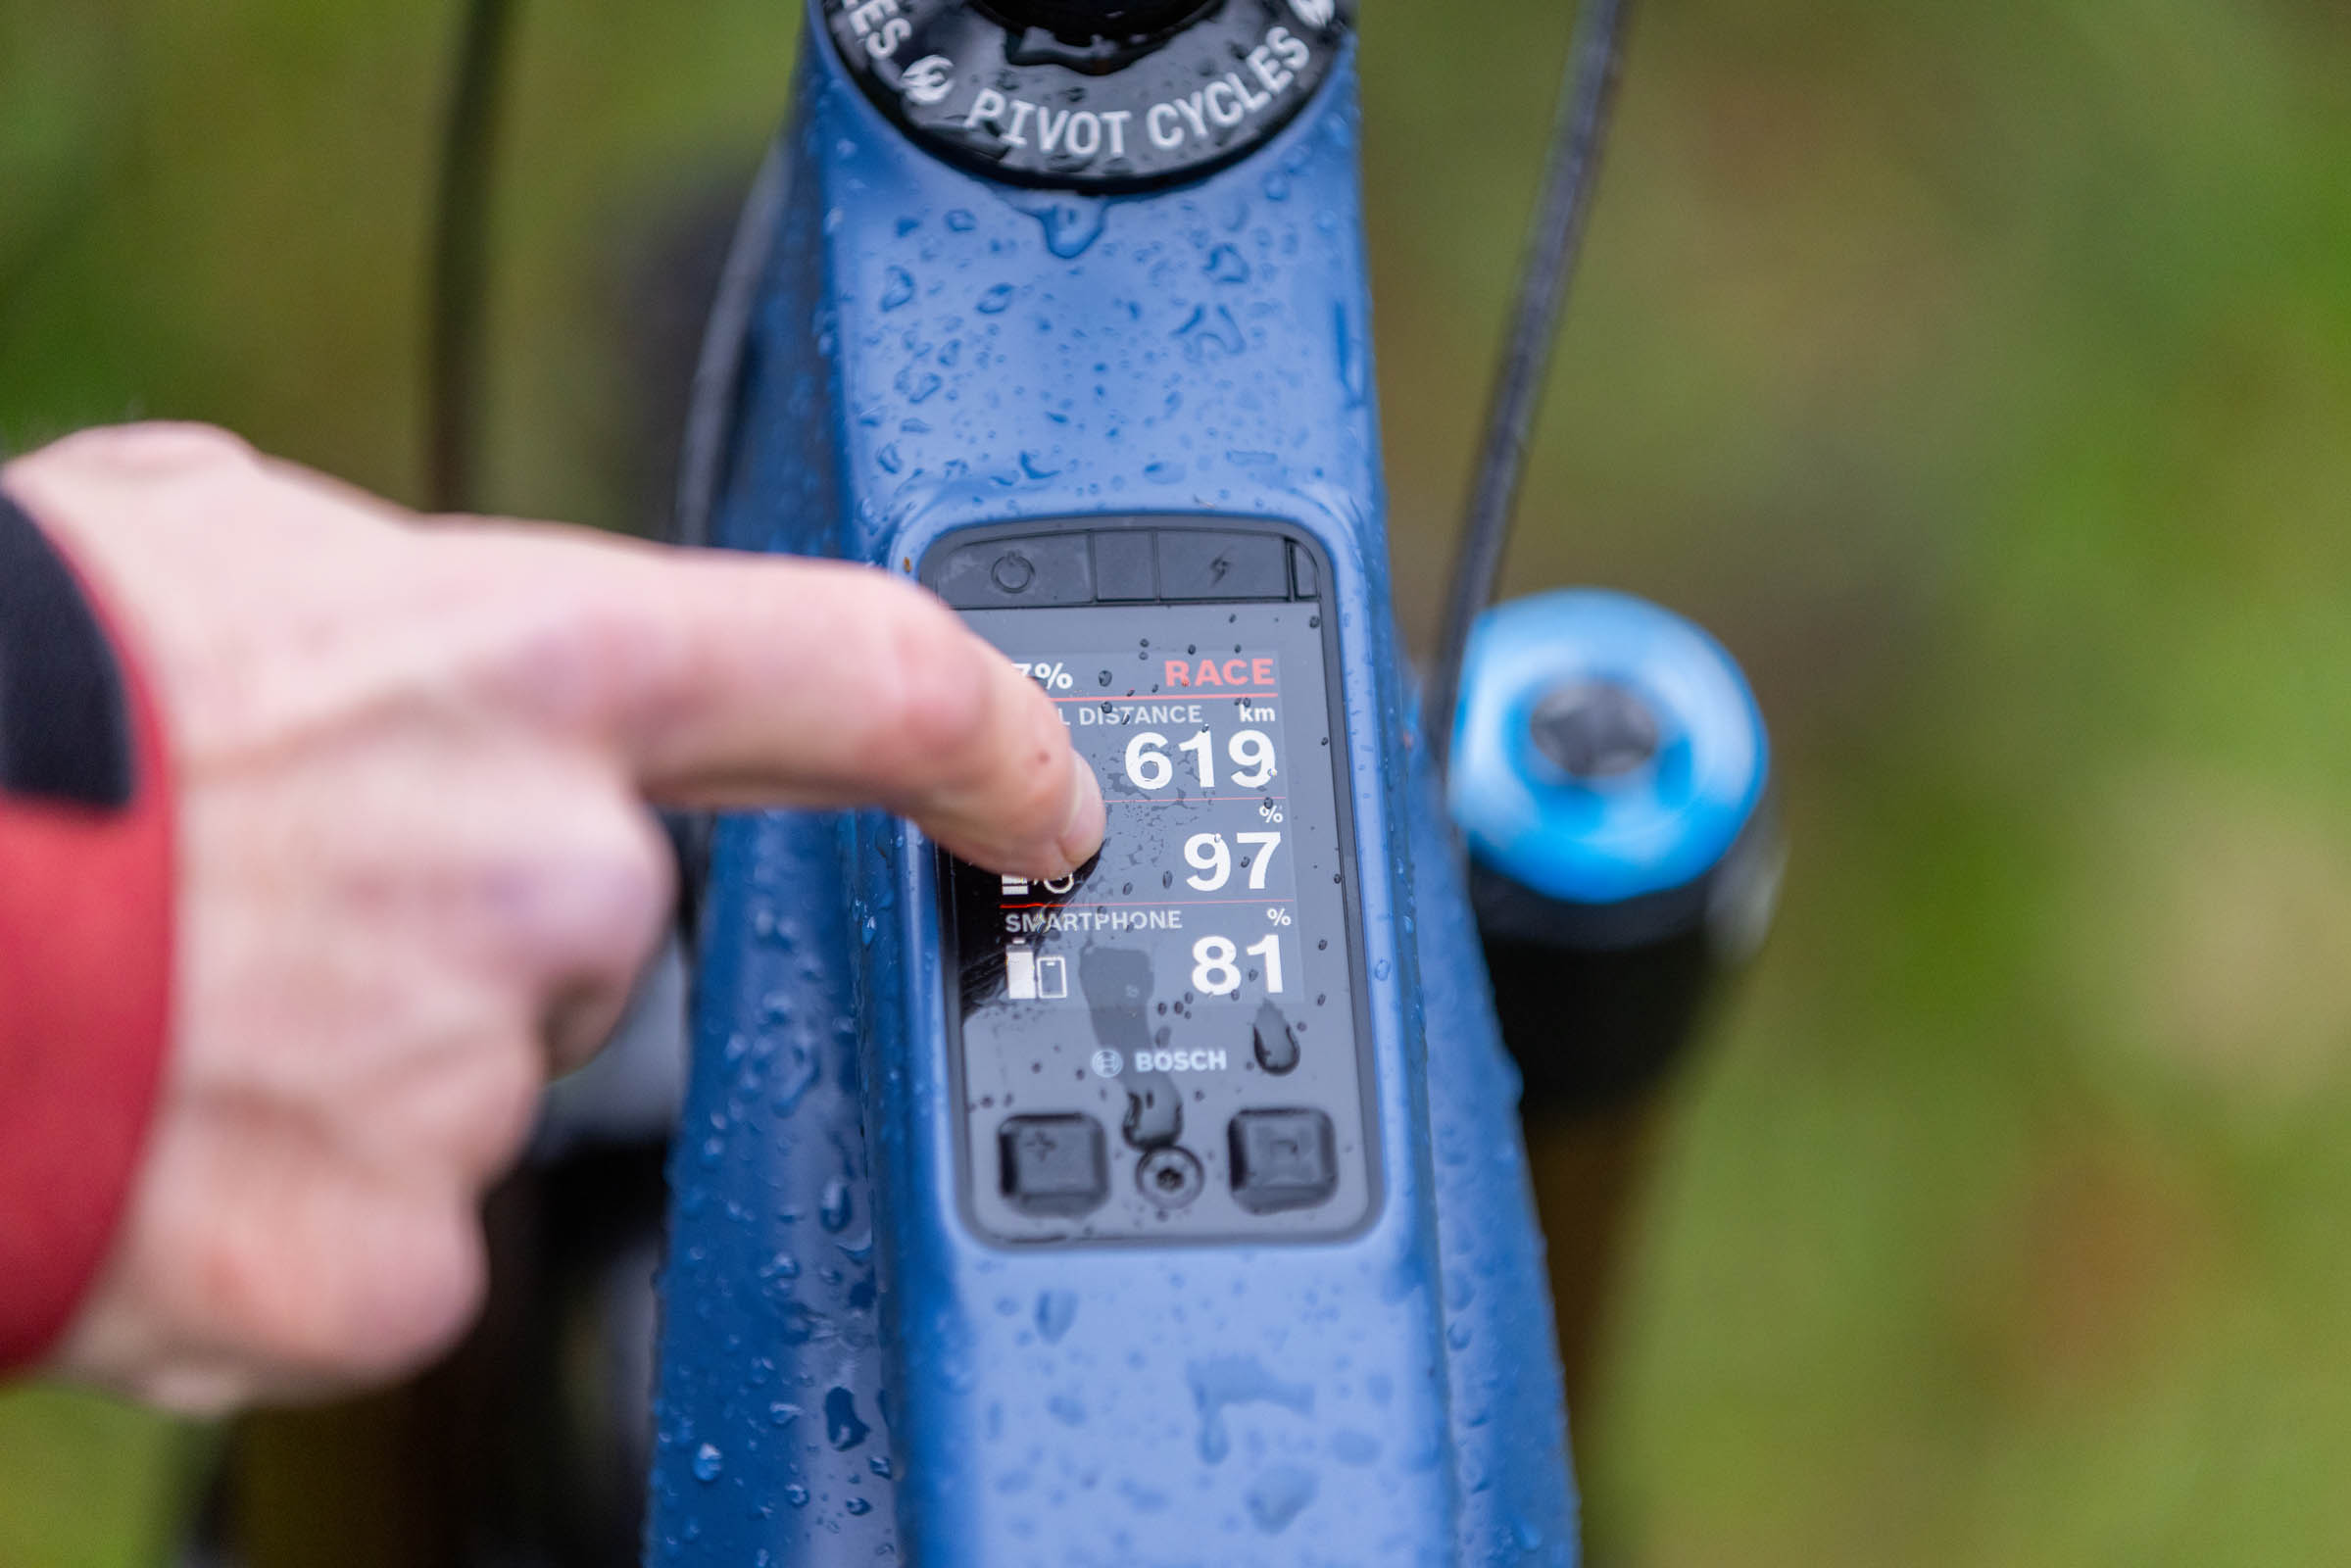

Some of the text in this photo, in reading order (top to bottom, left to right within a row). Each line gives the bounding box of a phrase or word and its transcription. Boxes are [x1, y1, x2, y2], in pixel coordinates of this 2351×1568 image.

[963, 26, 1310, 157] PIVOT CYCLES
[1164, 658, 1275, 687] RACE
[1079, 705, 1203, 726] DISTANCE
[1239, 703, 1276, 723] km
[1124, 729, 1276, 790] 619
[1258, 804, 1284, 823] %
[1183, 832, 1282, 892] 97
[1004, 907, 1292, 933] SMARTPHONE %
[1191, 934, 1284, 997] 81
[1134, 1050, 1228, 1073] BOSCH
